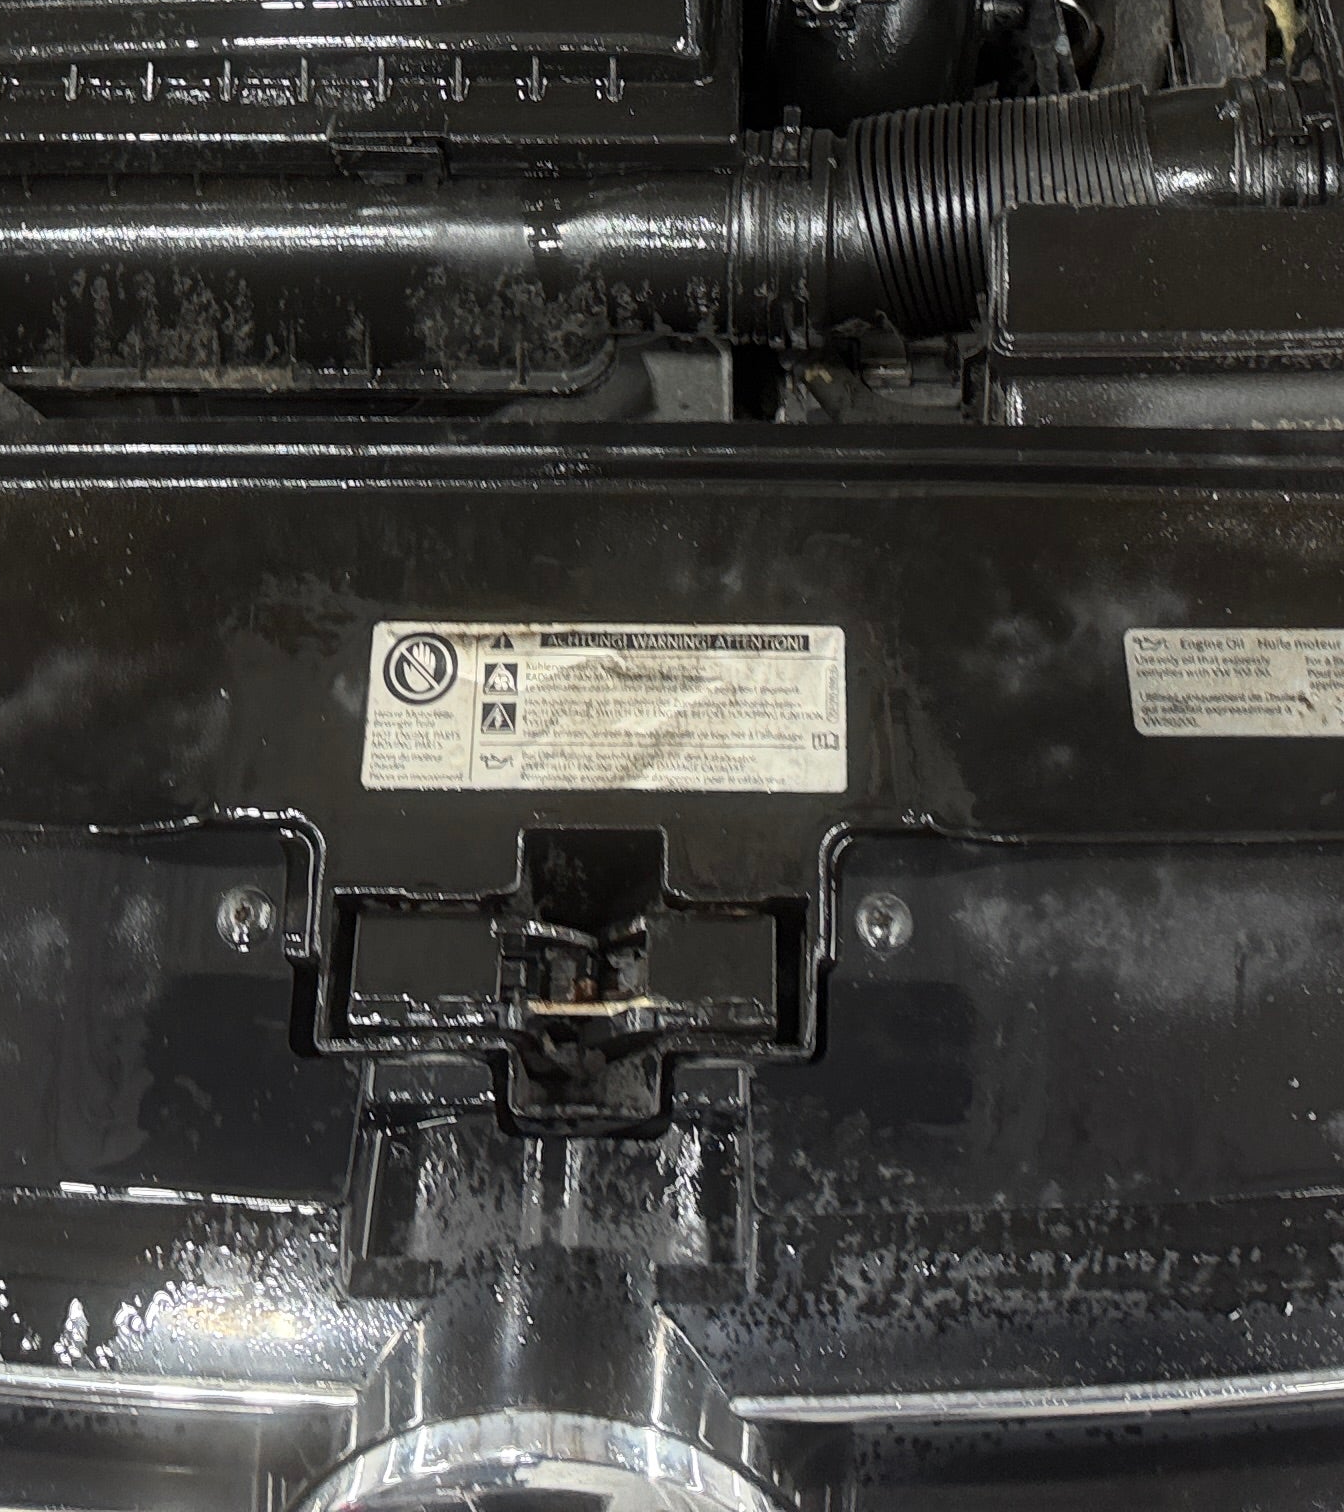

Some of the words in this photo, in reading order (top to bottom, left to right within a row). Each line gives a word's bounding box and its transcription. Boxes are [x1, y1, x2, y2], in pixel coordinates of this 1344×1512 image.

[1180, 637, 1223, 652] Engine
[1226, 637, 1245, 650] Oil
[1294, 637, 1342, 650] moteur
